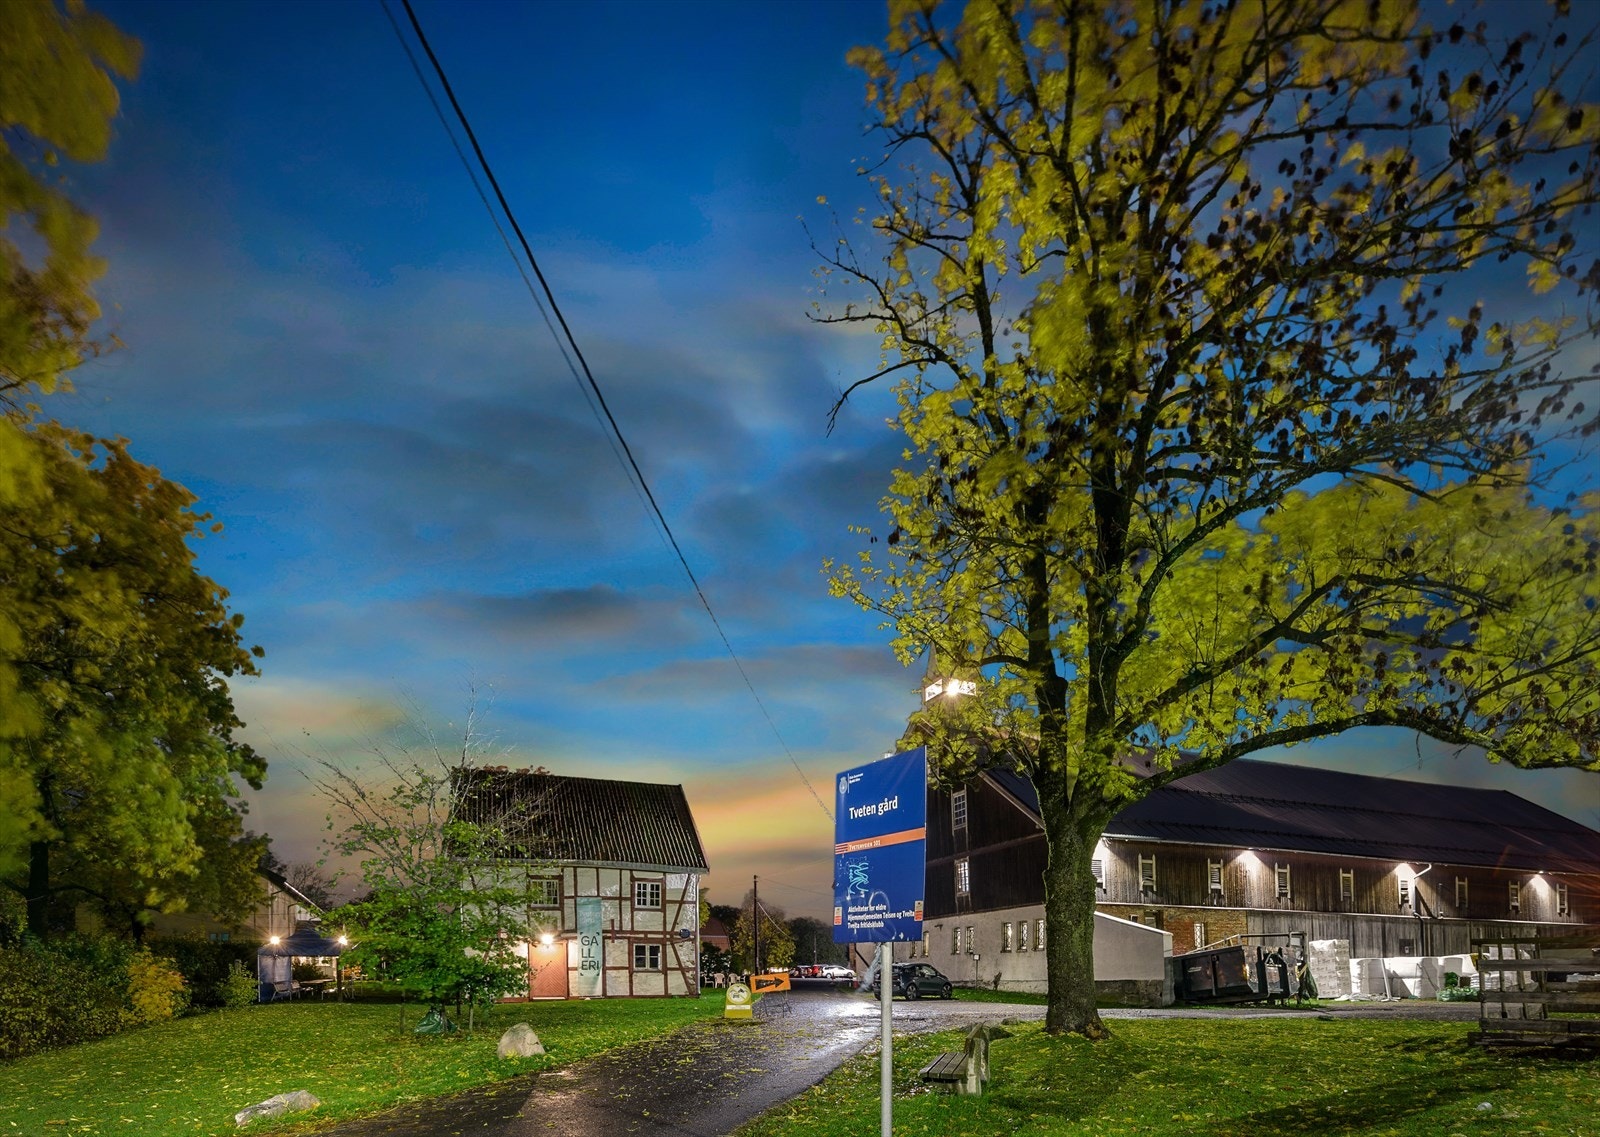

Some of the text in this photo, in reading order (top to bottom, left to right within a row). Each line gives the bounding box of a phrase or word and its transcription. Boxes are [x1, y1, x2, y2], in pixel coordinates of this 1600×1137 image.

[849, 795, 898, 820] Tveten gård
[848, 905, 869, 913] Aktiviteter
[875, 903, 887, 911] eldre
[896, 912, 902, 920] og
[580, 935, 599, 947] GA
[581, 948, 595, 959] LL
[581, 960, 600, 971] ERI
